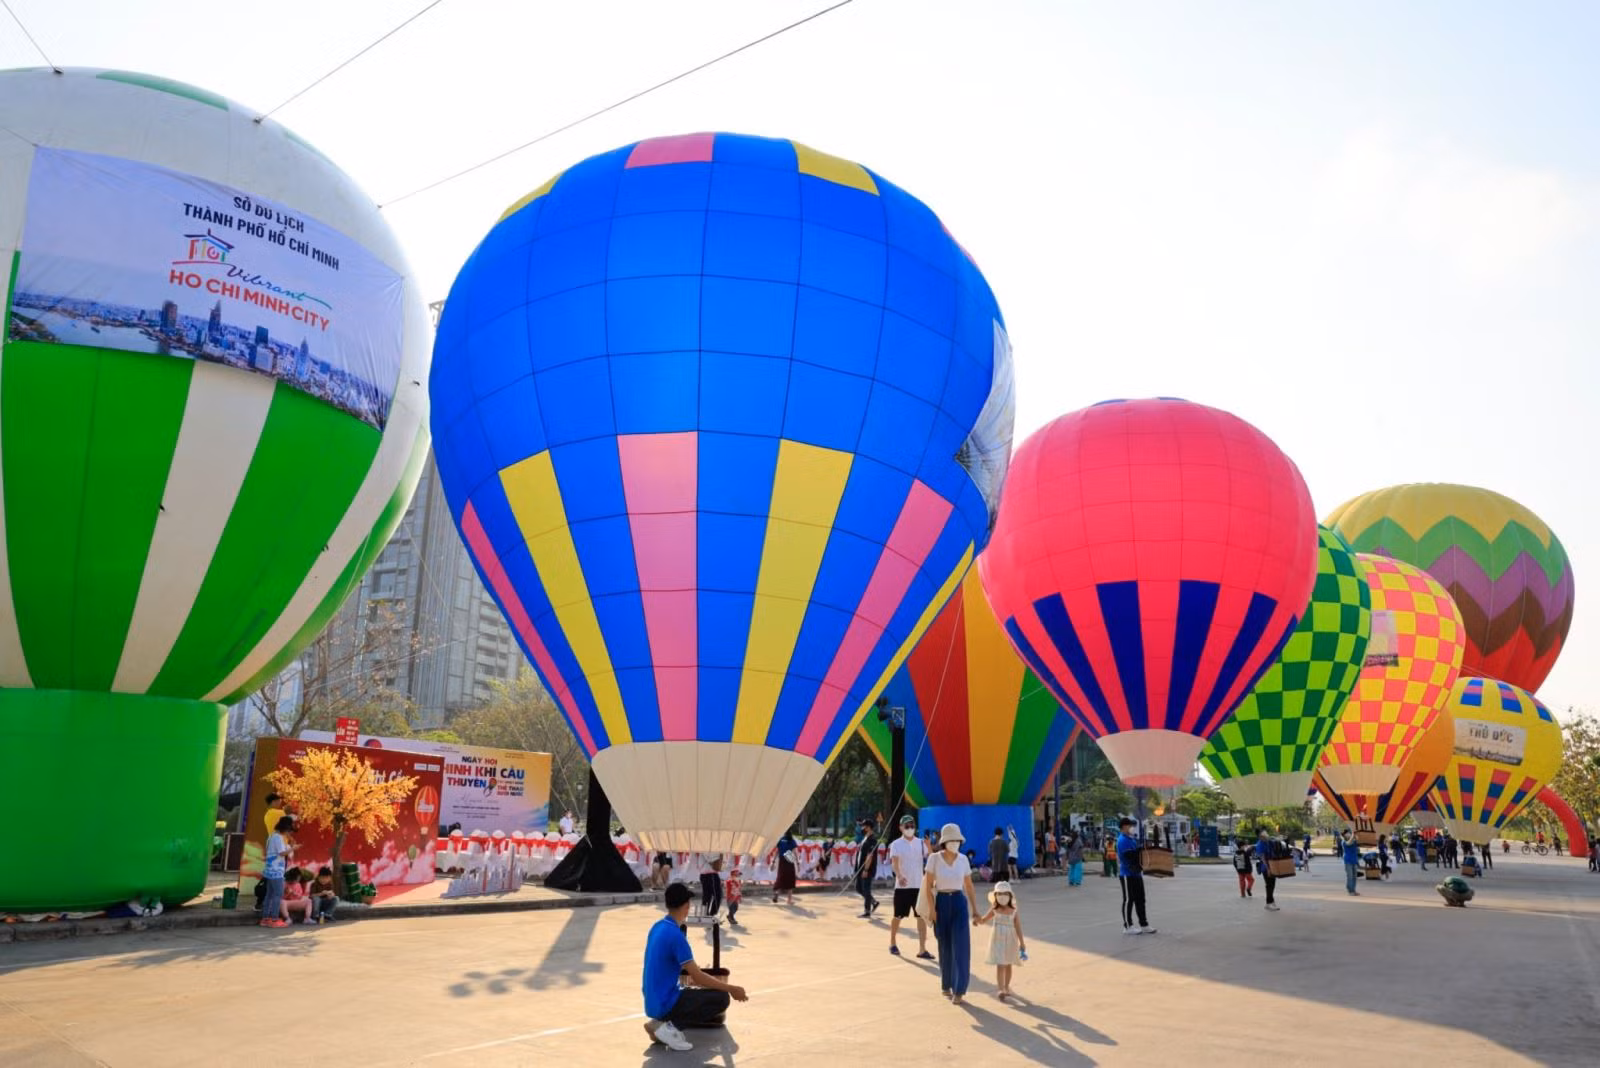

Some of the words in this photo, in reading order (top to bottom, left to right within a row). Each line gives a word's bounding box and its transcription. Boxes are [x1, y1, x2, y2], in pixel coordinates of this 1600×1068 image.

[183, 202, 233, 228] THÀNH
[237, 218, 266, 238] PHỐ
[268, 229, 286, 246] HỒ
[289, 238, 309, 256] CHÍ
[312, 247, 339, 271] MINH
[233, 196, 250, 212] SỞ
[255, 204, 272, 221] DU
[276, 212, 304, 233] LỊCH
[169, 269, 202, 289] HO
[206, 278, 240, 299] CHI
[243, 288, 289, 316] MINH
[291, 306, 330, 332] CITY
[227, 263, 310, 302] Vibrant
